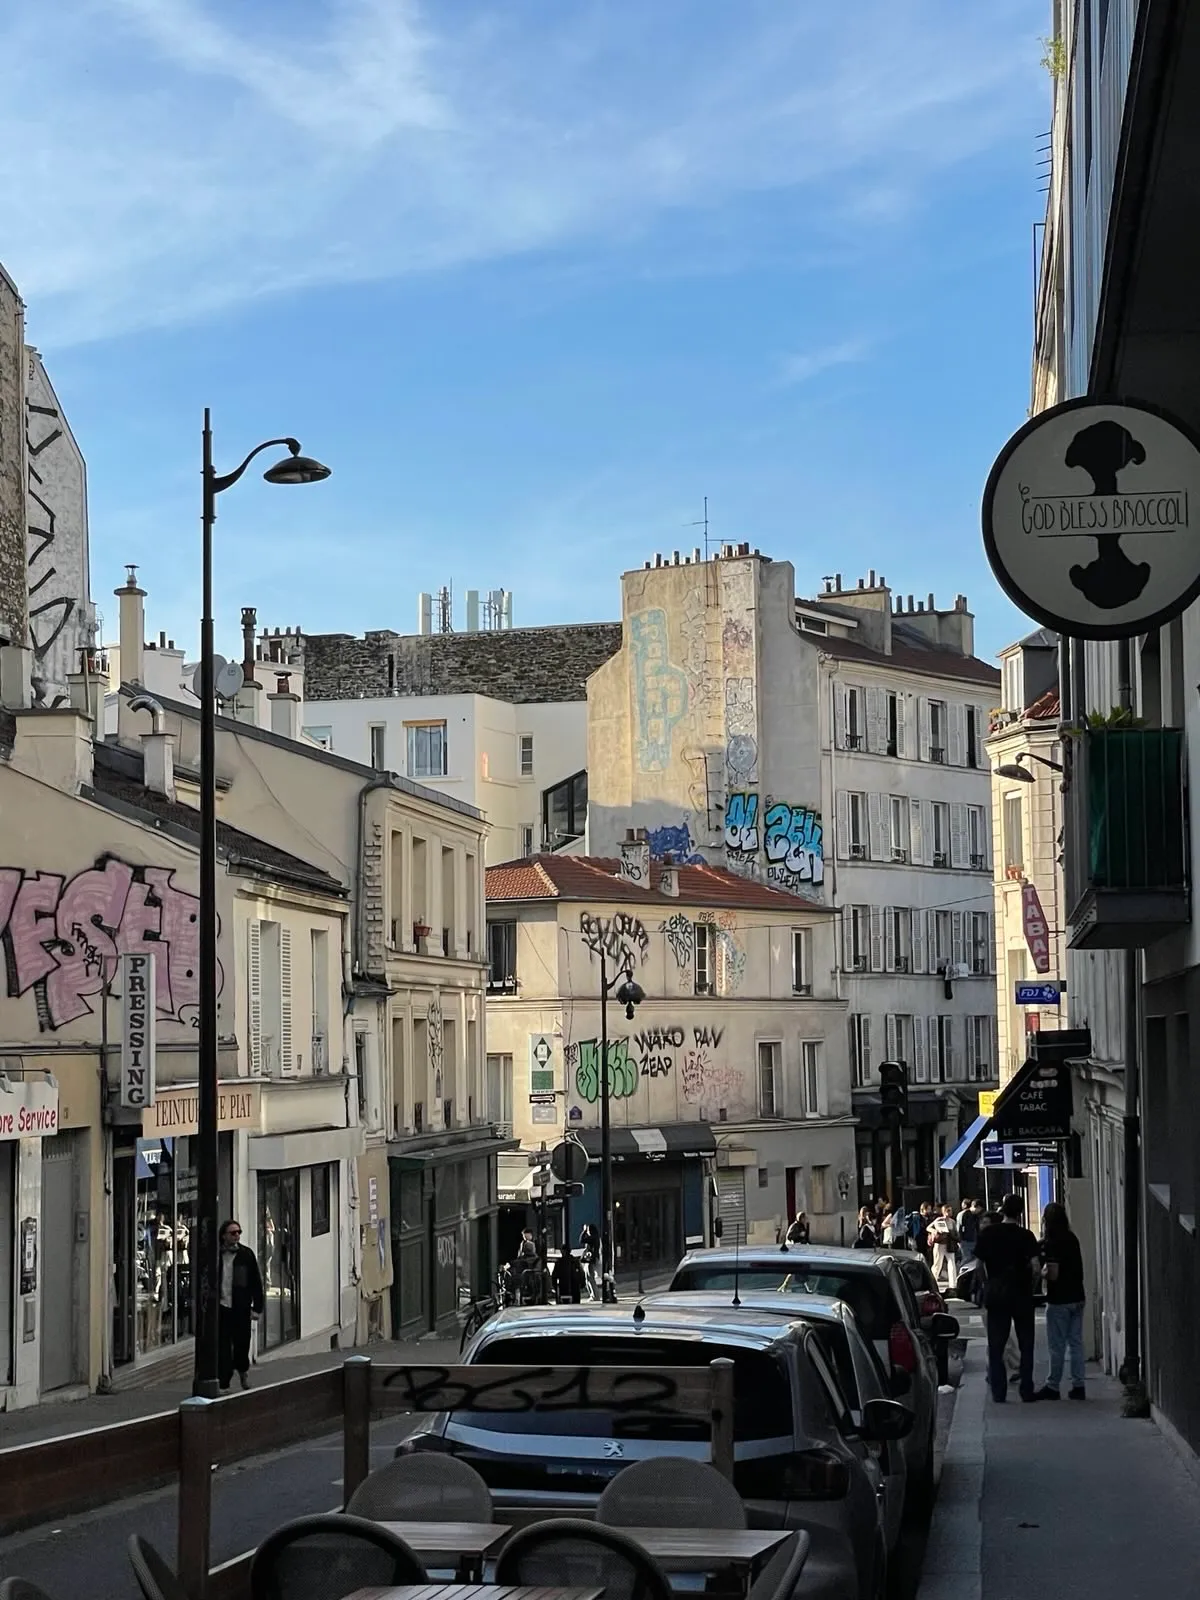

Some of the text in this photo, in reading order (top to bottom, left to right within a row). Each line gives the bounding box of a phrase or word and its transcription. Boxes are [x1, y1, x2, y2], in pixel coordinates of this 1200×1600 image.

[1018, 482, 1189, 534] GOD BLESS BROCCOLI
[1023, 887, 1049, 969] TABAC
[1021, 988, 1040, 997] FDJ
[127, 957, 146, 1105] PRESSING
[633, 1025, 685, 1053] WAKO
[639, 1055, 672, 1078] ZEAP
[230, 1093, 252, 1119] PIAT
[1019, 1102, 1048, 1112] TABAC
[1020, 1090, 1044, 1100] CAFÉ
[18, 1105, 56, 1132] Service
[1003, 1127, 1013, 1137] LE
